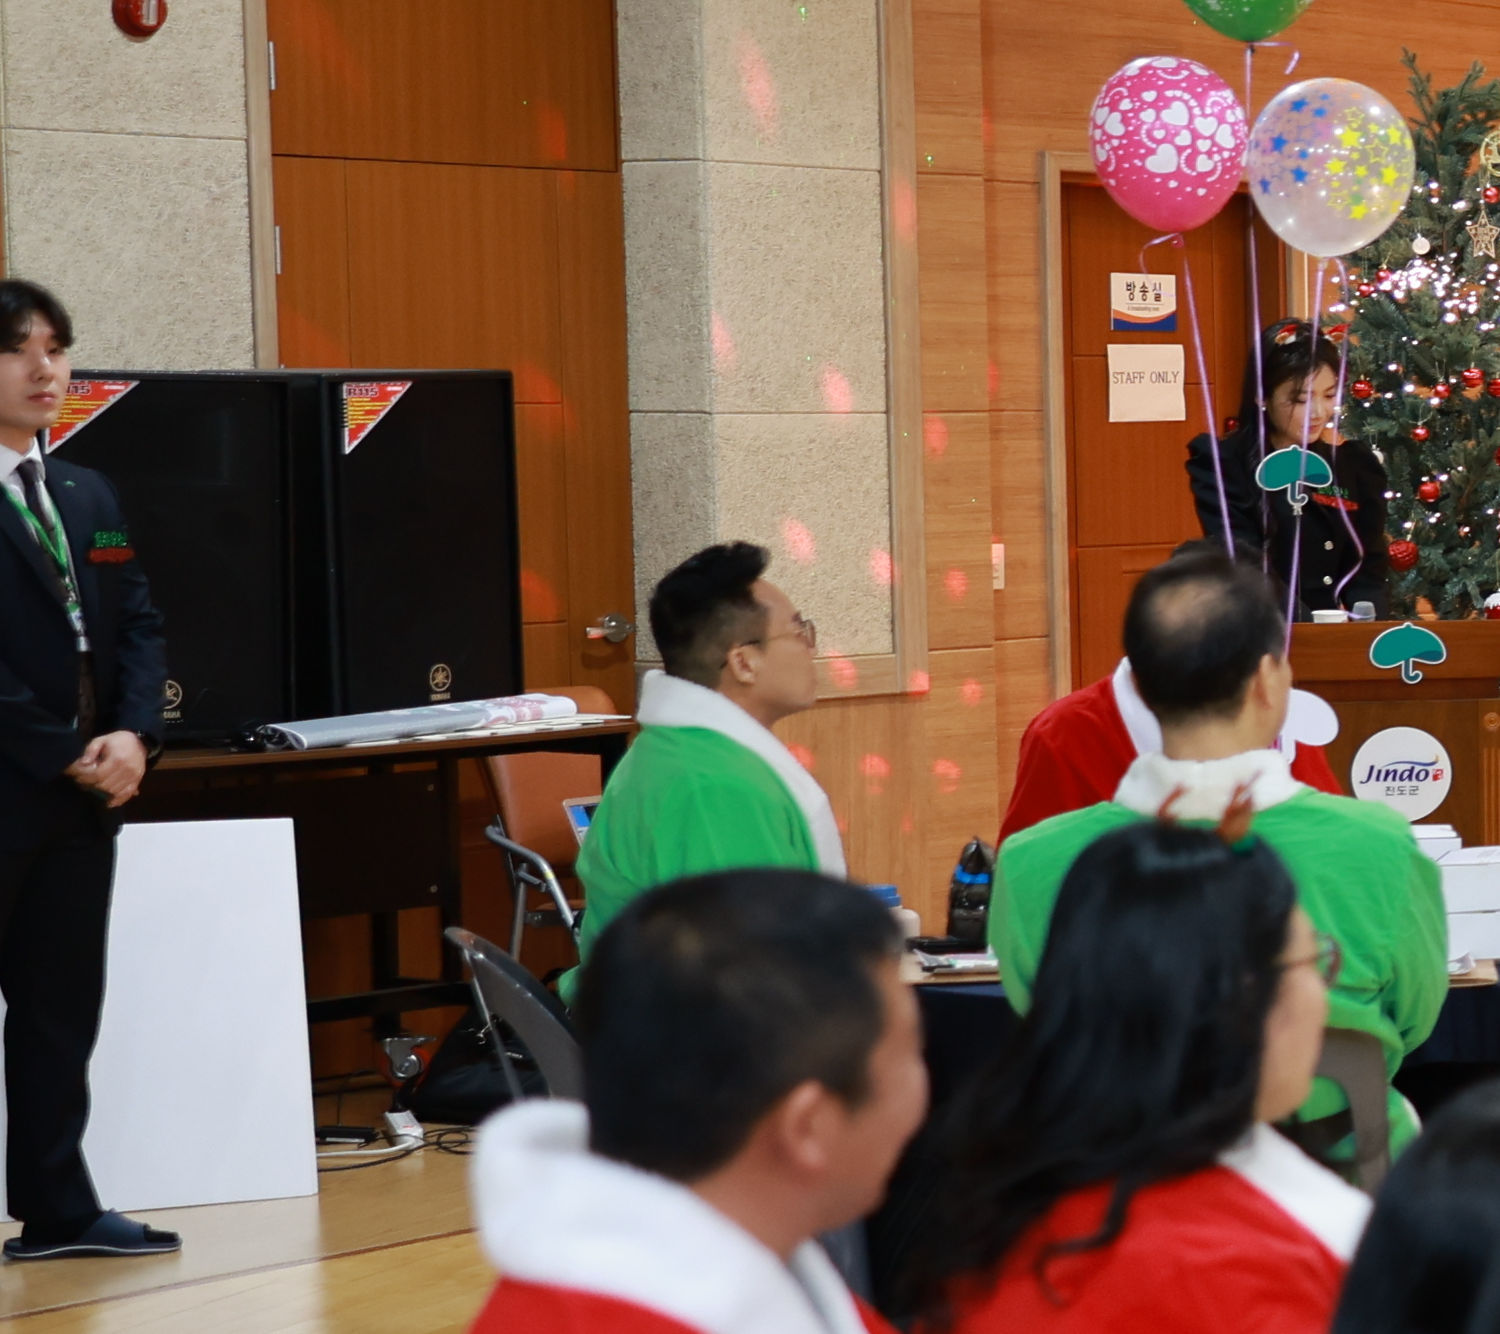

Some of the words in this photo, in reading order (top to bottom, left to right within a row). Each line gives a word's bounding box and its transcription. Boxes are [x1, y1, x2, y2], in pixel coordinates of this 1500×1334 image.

[1125, 281, 1163, 303] 방송실
[1113, 372, 1145, 384] STAFF
[1150, 371, 1179, 384] ONLY
[1359, 765, 1430, 785] Jindo
[1385, 785, 1420, 797] 진도군
